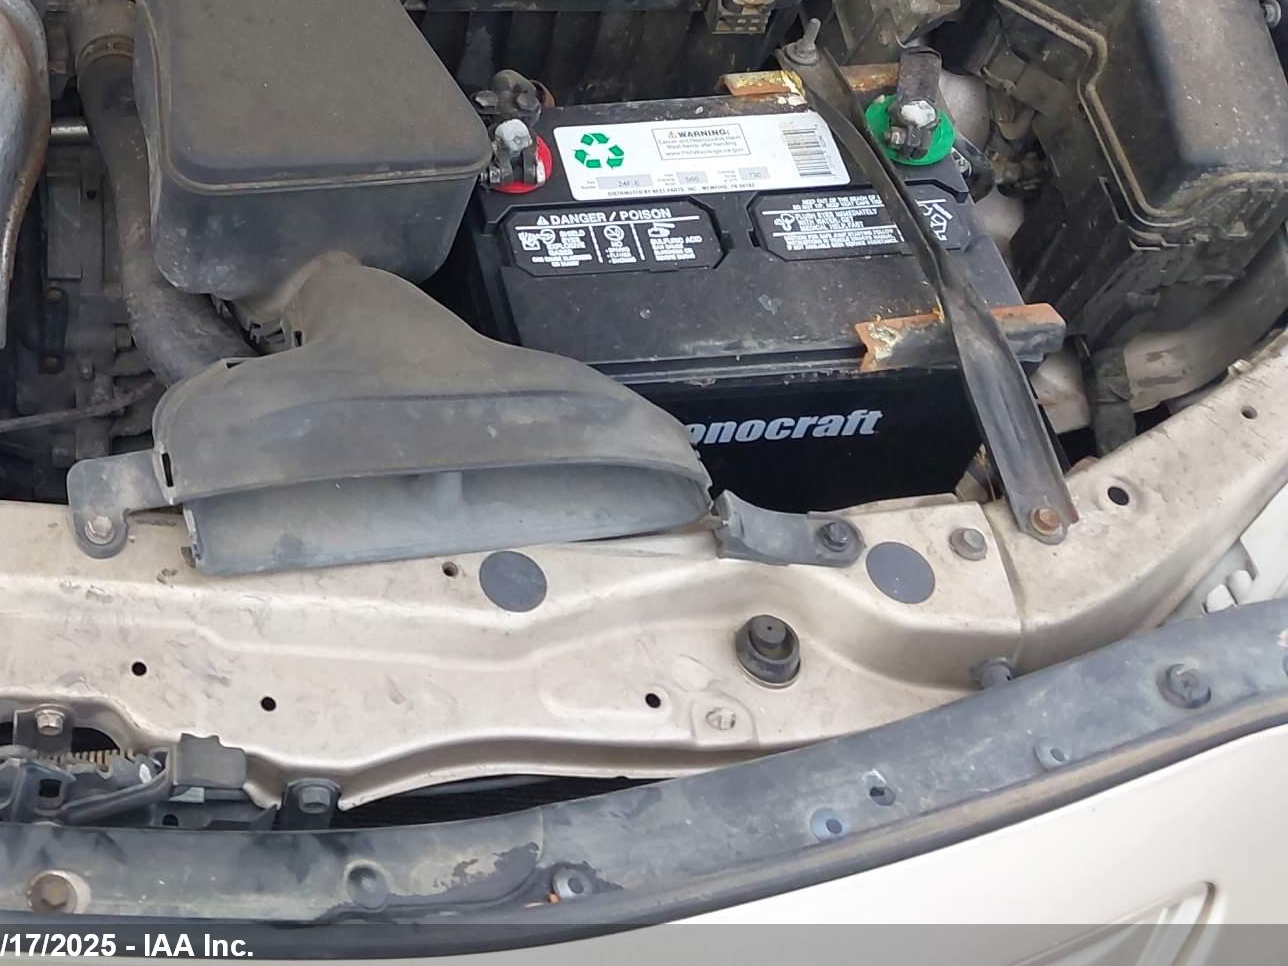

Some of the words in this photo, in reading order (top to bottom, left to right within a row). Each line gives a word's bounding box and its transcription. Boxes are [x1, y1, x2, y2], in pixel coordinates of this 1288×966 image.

[550, 212, 606, 226] DANGER
[609, 211, 616, 222] /
[621, 208, 672, 221] POISON
[685, 409, 884, 445] onocraft
